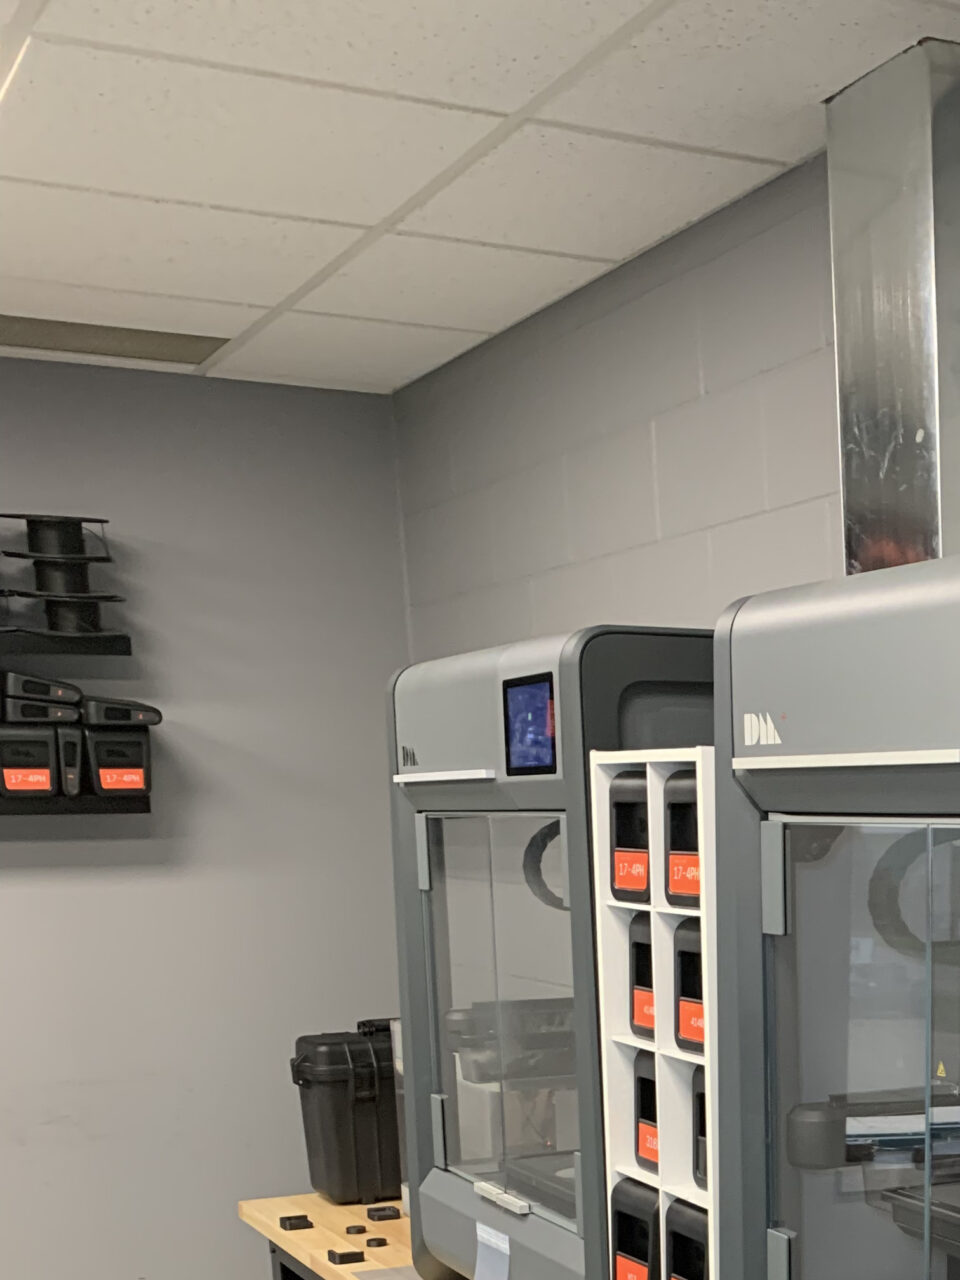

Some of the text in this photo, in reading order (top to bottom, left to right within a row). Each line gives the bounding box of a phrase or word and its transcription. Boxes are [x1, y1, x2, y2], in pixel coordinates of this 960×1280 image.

[10, 774, 46, 784] 17-4PH
[106, 773, 140, 783] 17-4PH
[618, 863, 645, 877] 17-4PH
